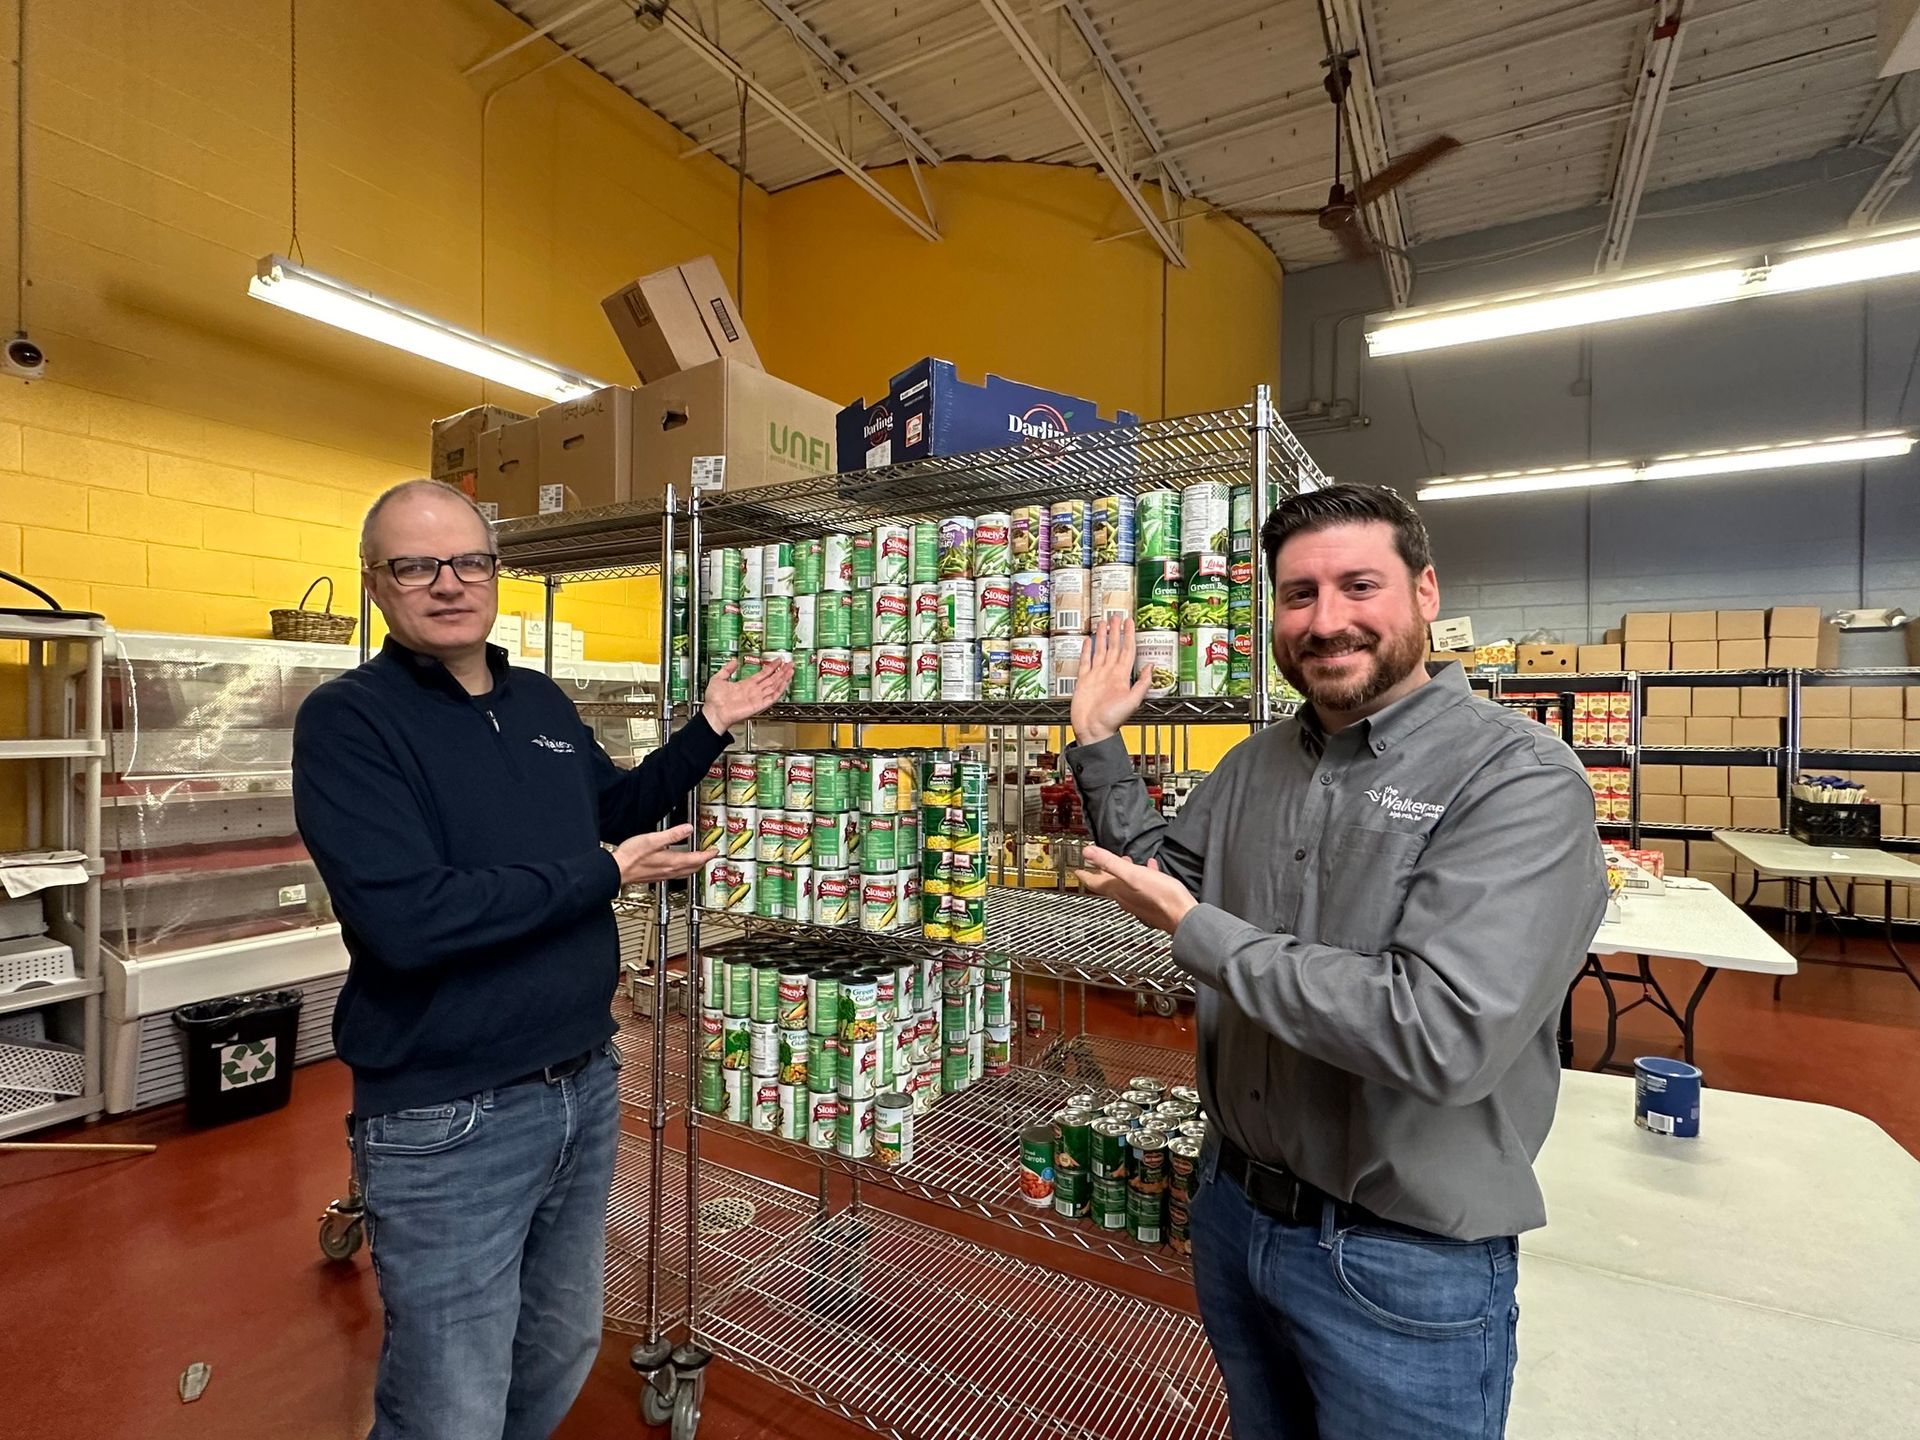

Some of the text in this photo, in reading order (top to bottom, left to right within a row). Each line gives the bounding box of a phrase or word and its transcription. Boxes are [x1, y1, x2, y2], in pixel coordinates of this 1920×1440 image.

[863, 412, 893, 439] Darling
[886, 538, 908, 551] Stoke
[1190, 582, 1215, 592] Green
[879, 597, 906, 611] Stokely
[920, 596, 938, 606] Stok
[1211, 642, 1228, 655] Stok
[879, 656, 905, 669] Stokely
[920, 656, 937, 666] Stok
[790, 767, 812, 778] Stoke
[1385, 785, 1399, 796] the
[1380, 793, 1428, 814] Walker
[821, 881, 848, 894] Stokely
[760, 1088, 778, 1098] Stok
[1024, 1154, 1047, 1164] carrots
